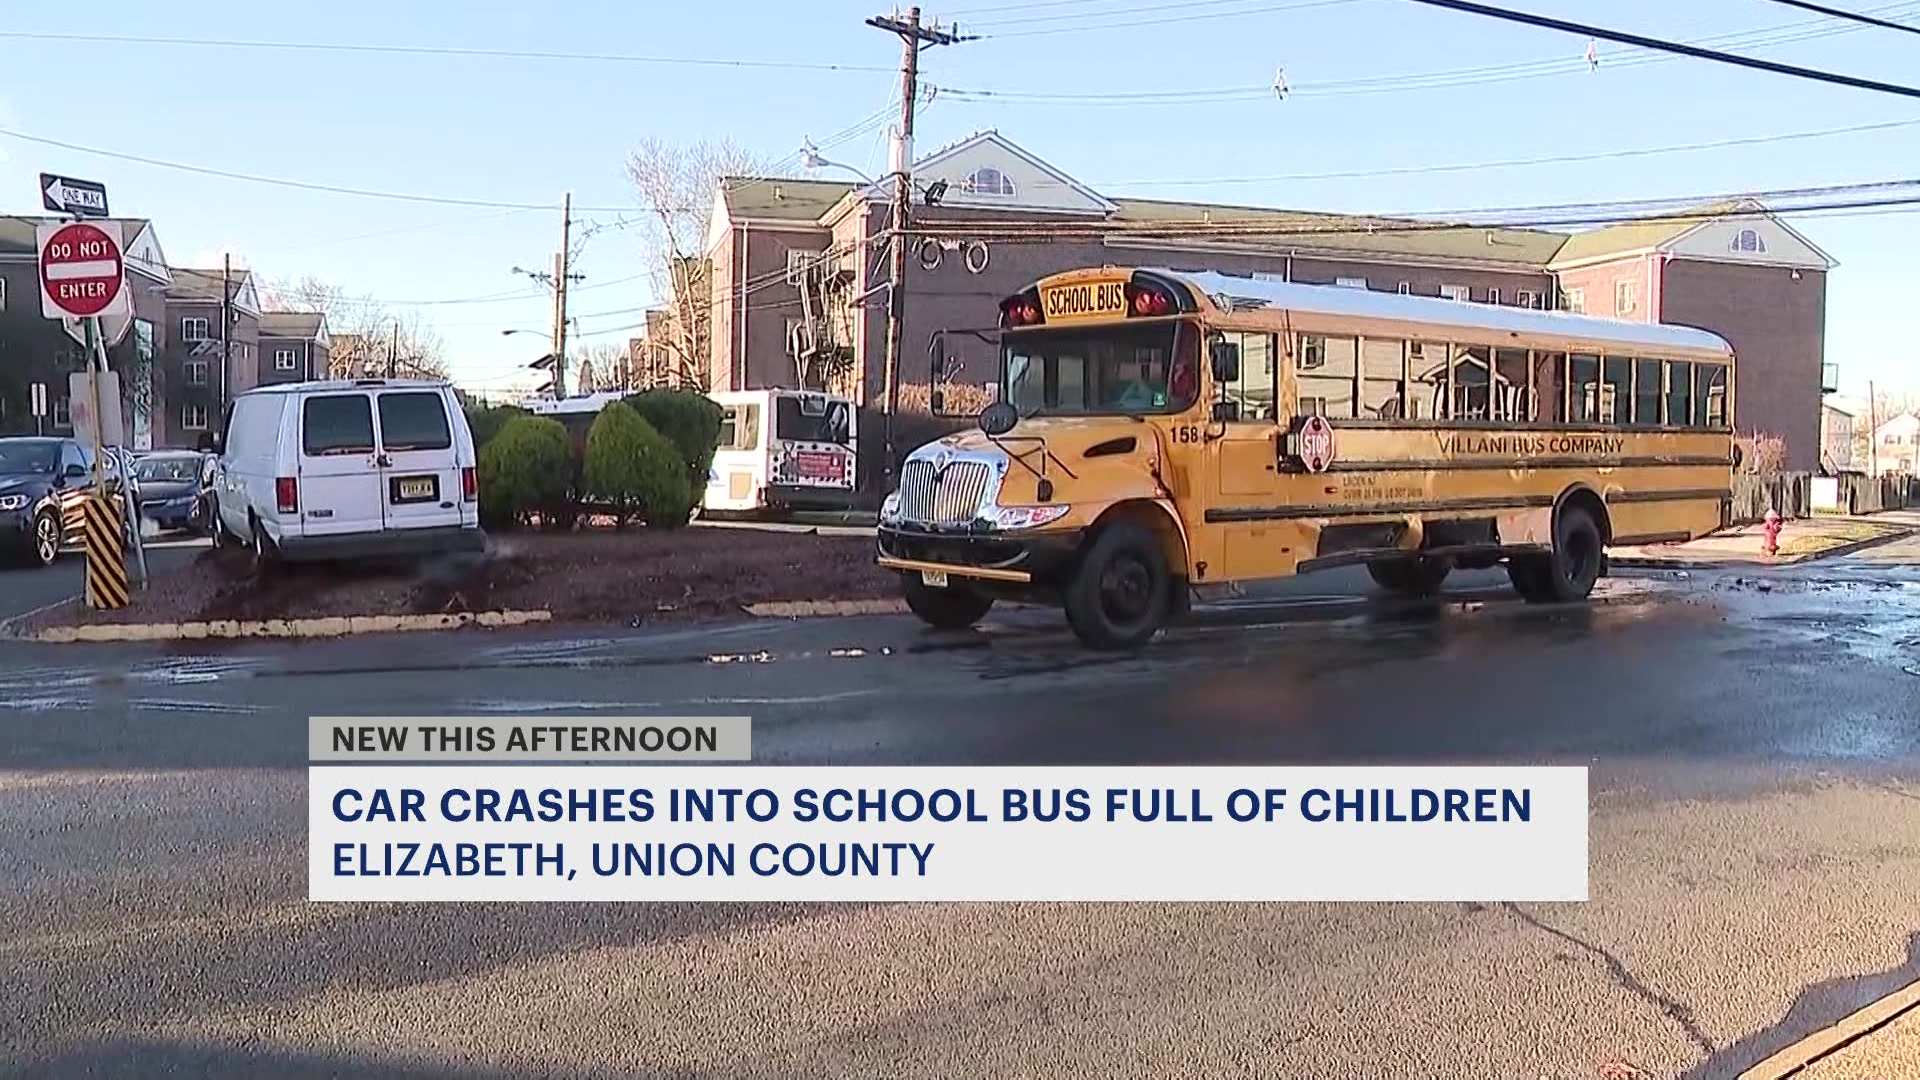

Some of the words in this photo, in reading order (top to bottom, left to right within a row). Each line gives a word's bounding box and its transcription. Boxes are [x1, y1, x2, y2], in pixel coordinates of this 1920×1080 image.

[62, 188, 81, 204] ONE
[83, 192, 100, 207] WAY
[51, 243, 71, 258] DO
[80, 240, 109, 258] NOT
[59, 282, 107, 298] ENTER
[1049, 286, 1095, 315] SCHOOL
[1097, 284, 1122, 309] BUS
[1170, 426, 1198, 443] 158
[1304, 434, 1329, 456] STOP
[1439, 437, 1507, 454] VILLANI
[1512, 437, 1544, 454] BUS
[1549, 437, 1625, 454] COMPANY
